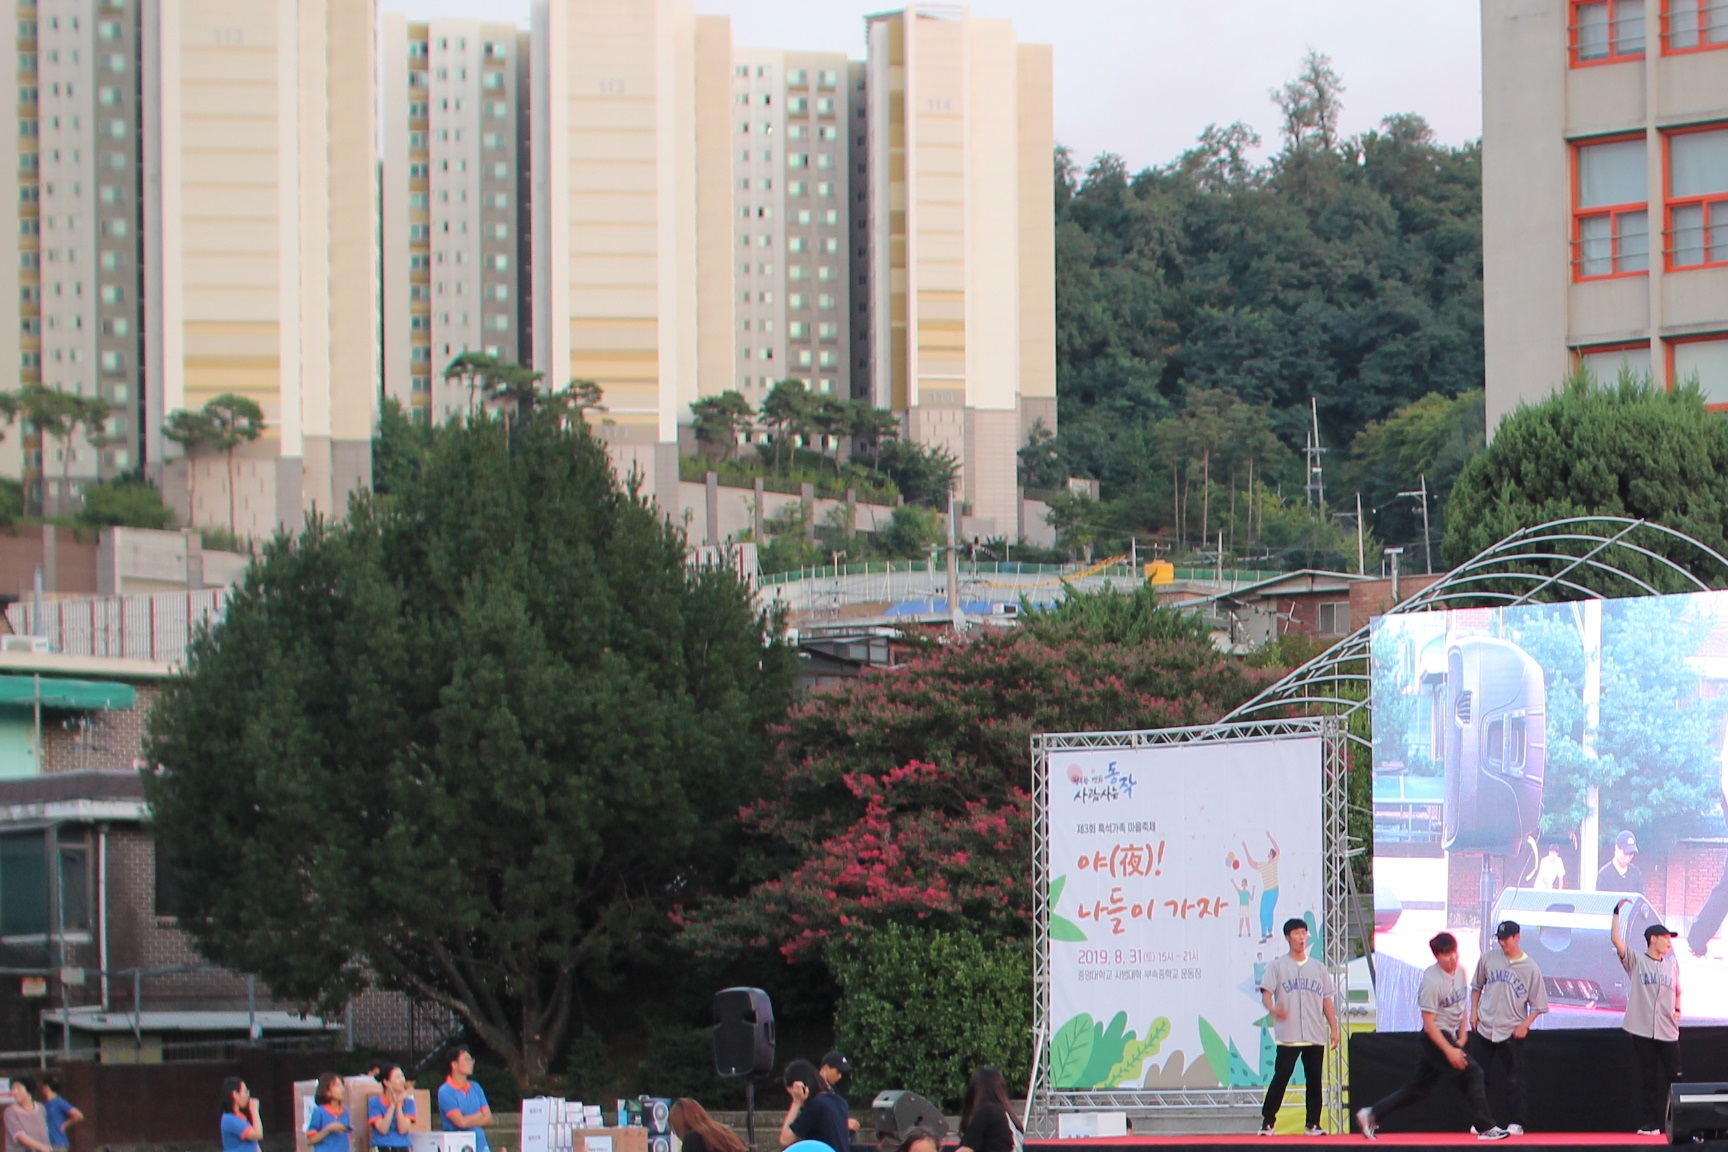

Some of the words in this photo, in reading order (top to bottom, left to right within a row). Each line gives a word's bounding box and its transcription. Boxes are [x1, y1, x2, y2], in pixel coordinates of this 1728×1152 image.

[1077, 823, 1096, 834] 제3회
[1098, 822, 1126, 834] 흑석가족
[1127, 821, 1156, 833] 마을축제
[1077, 840, 1166, 878] 야(夜)!
[1077, 887, 1155, 935] 나들이
[1163, 896, 1230, 920] 가자
[1078, 949, 1111, 965] 2019.
[1114, 949, 1126, 965] 8.
[1158, 951, 1174, 962] 15시
[1183, 950, 1199, 961] 21시
[1078, 970, 1112, 981] 중앙대학교
[1115, 969, 1142, 981] 사범대학
[1144, 968, 1179, 980] 부속중학교
[1181, 968, 1202, 979] 운동장
